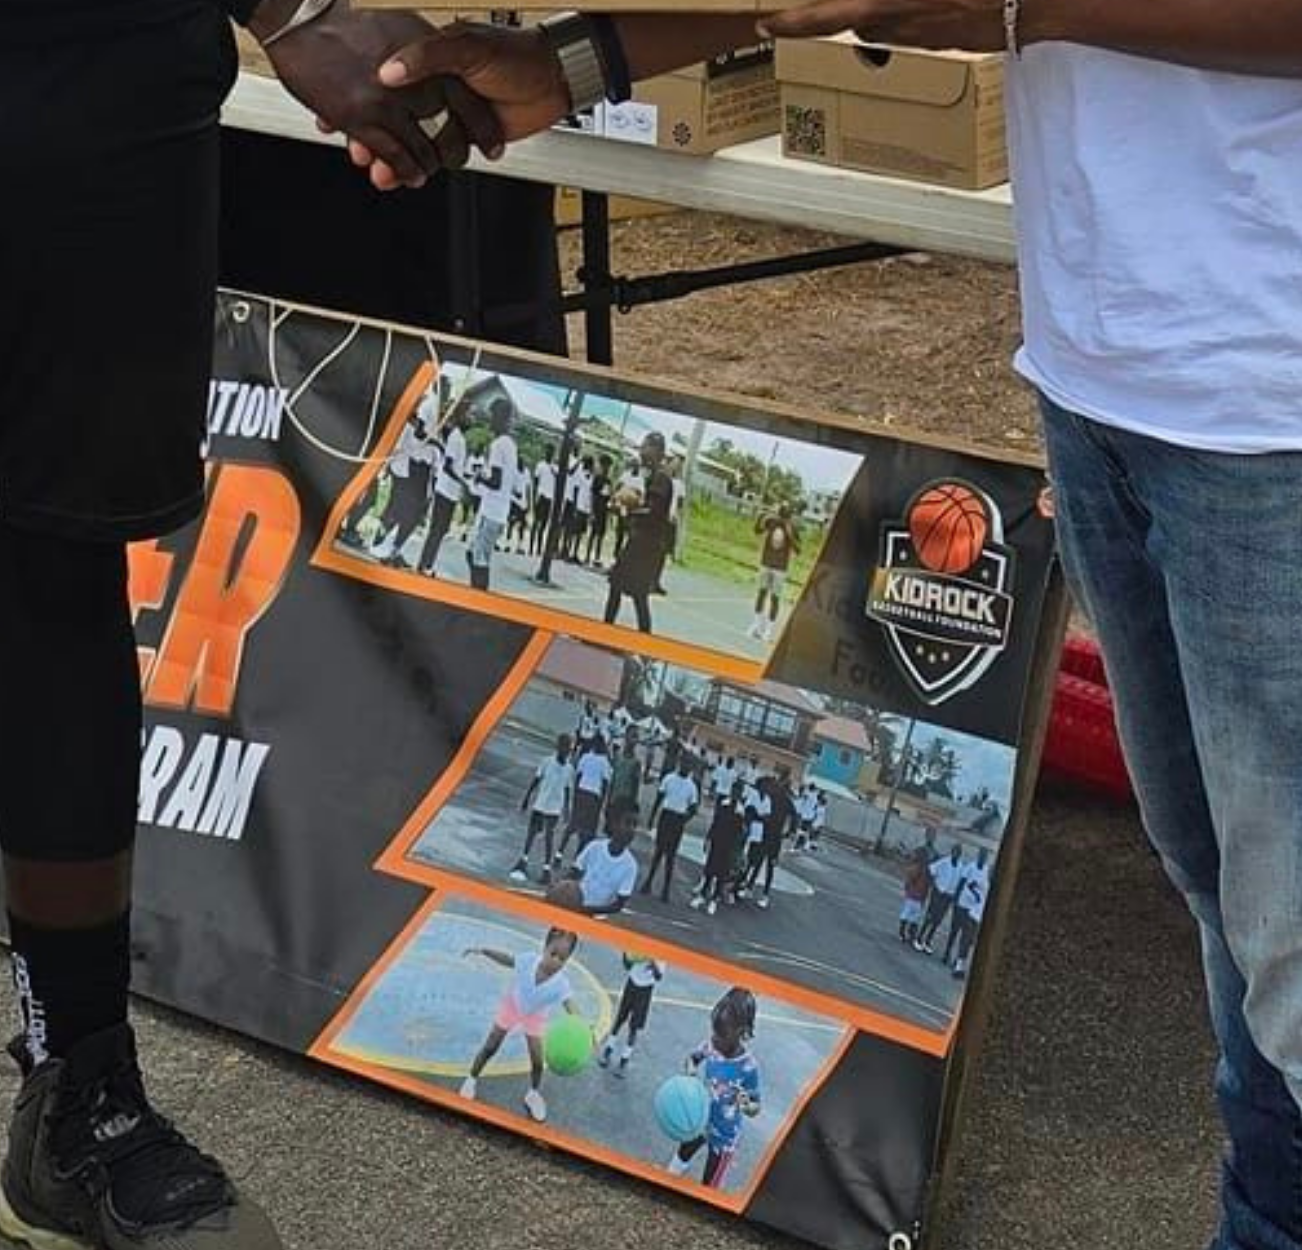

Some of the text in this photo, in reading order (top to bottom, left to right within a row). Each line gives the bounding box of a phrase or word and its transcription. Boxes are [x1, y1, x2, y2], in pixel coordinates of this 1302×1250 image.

[872, 600, 1003, 639] BASKETBALL FOUNDATION
[883, 569, 996, 625] KIDROCK
